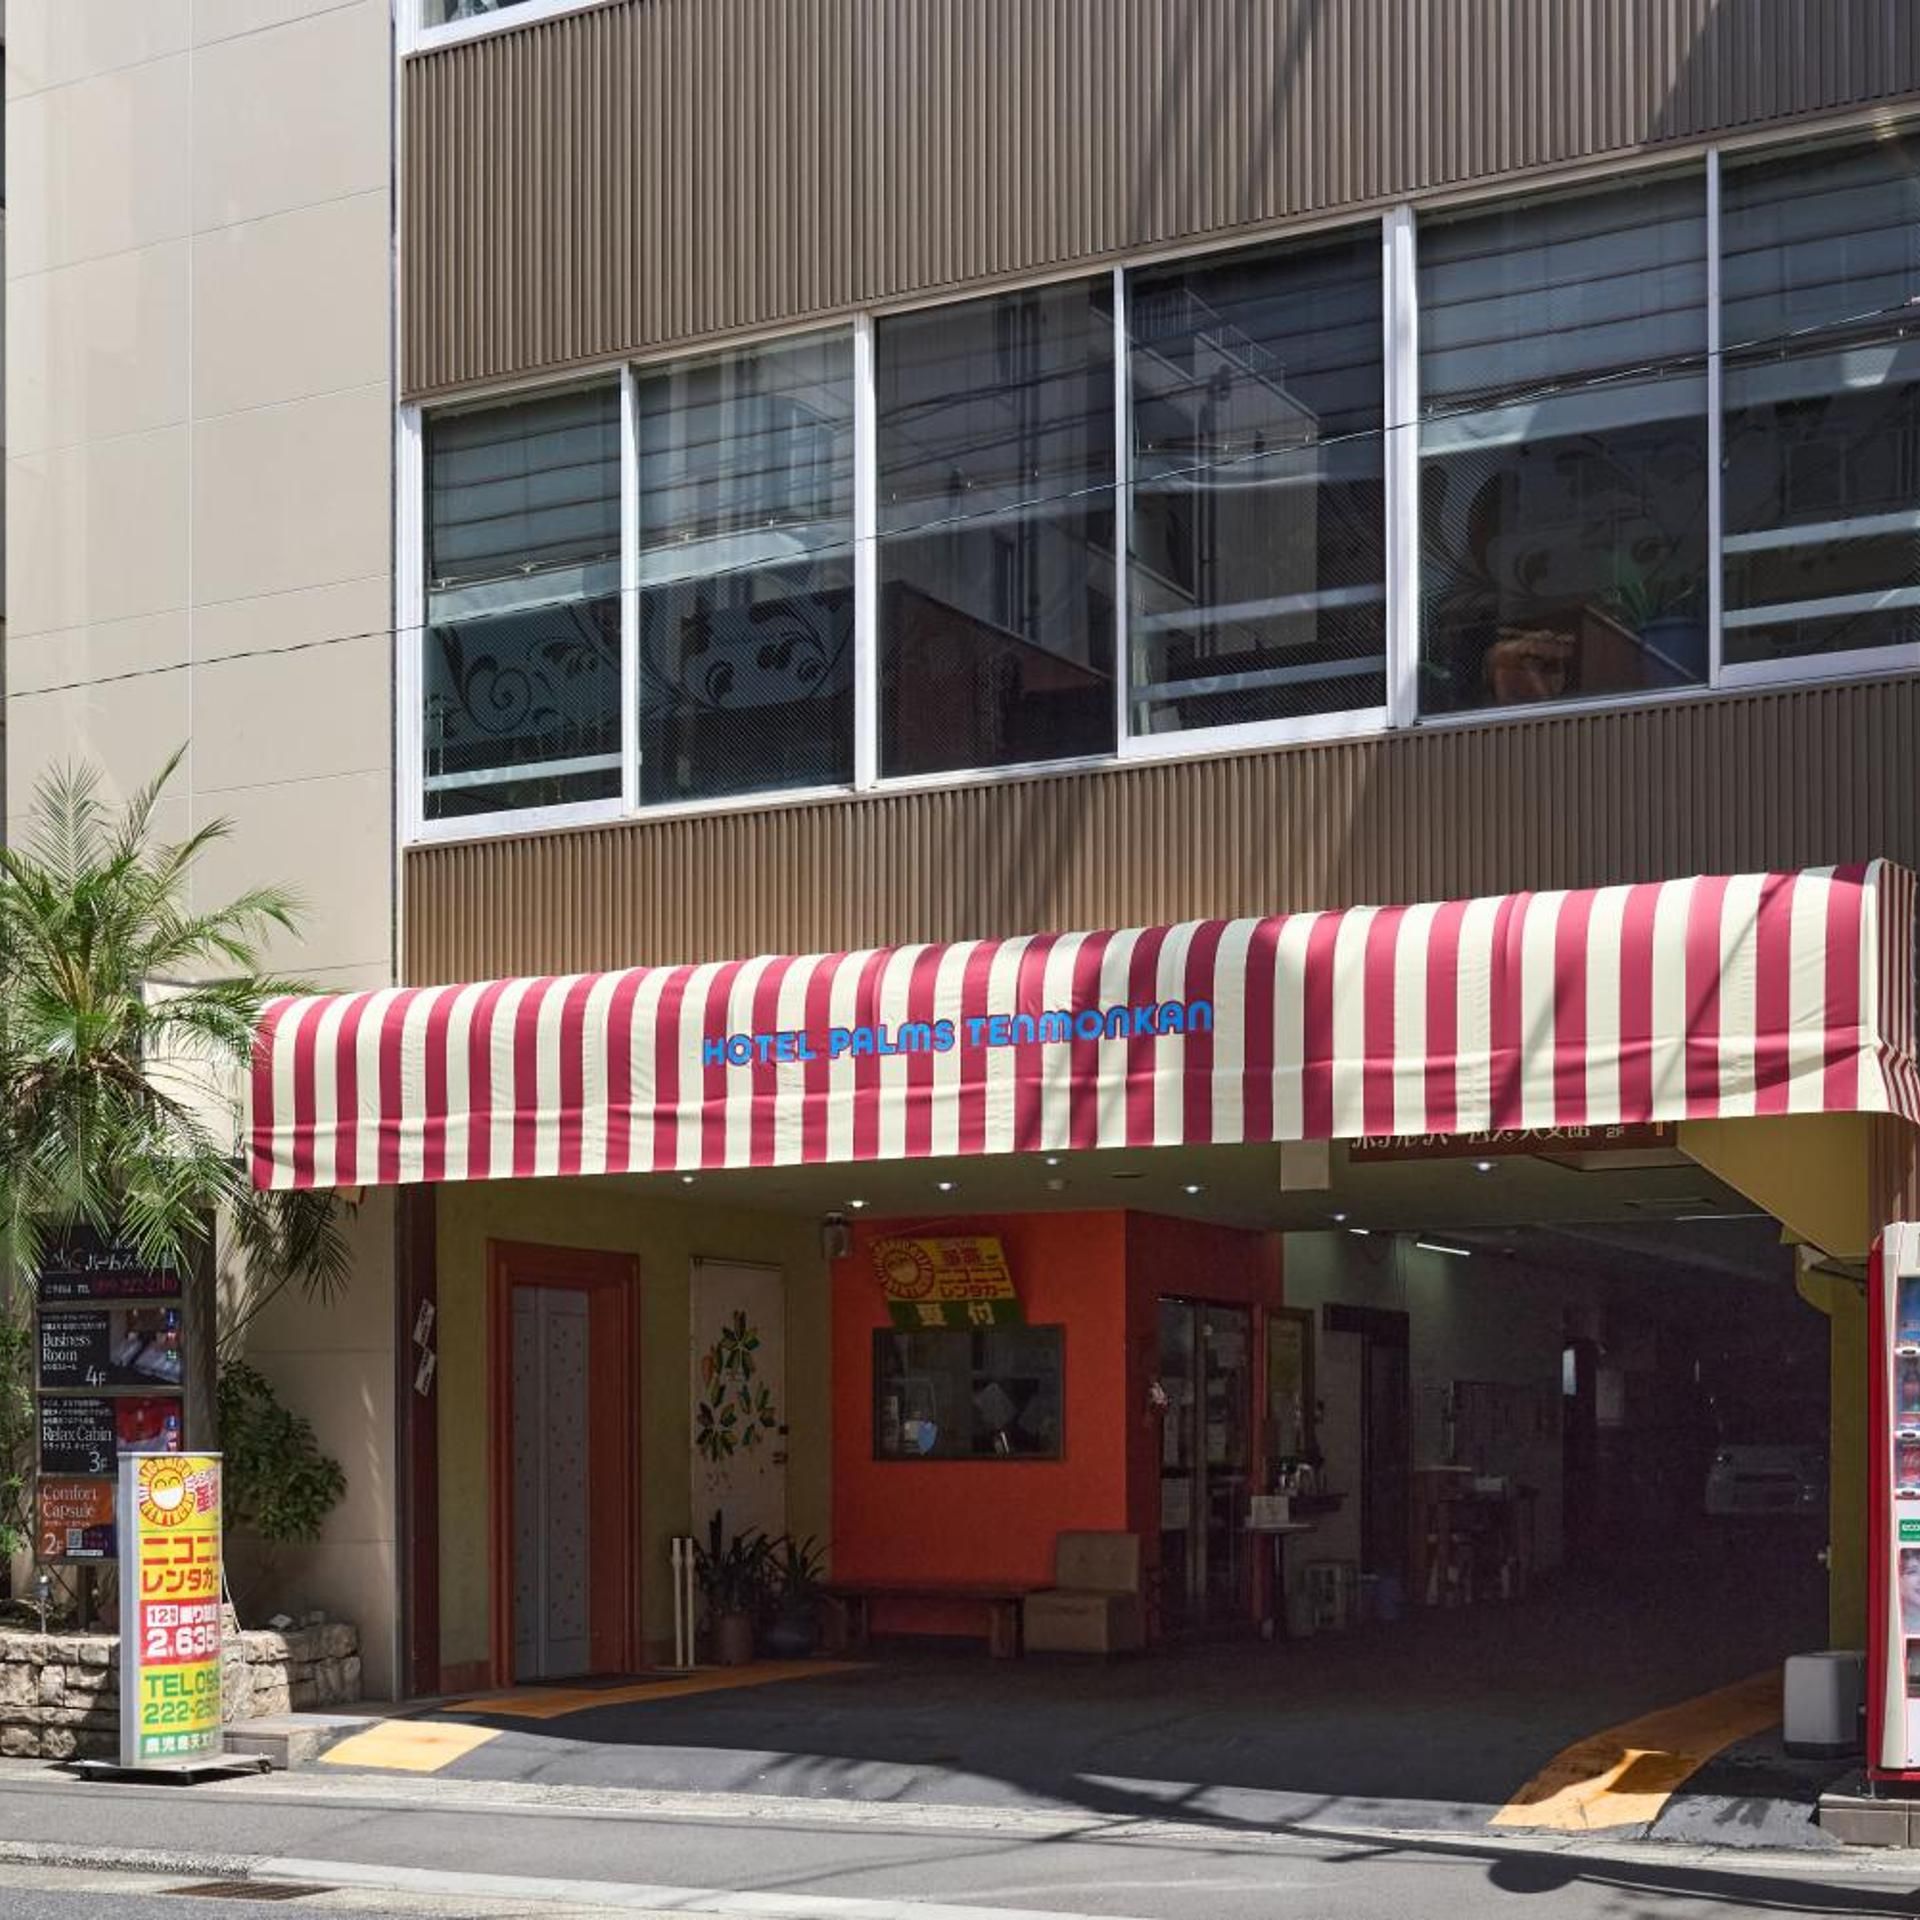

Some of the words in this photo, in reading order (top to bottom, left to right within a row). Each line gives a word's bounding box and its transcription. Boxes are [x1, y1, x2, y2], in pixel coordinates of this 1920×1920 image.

[703, 1032, 816, 1067] HOTEL
[829, 1020, 956, 1058] PALMS
[966, 1000, 1213, 1048] TENMONKAN
[42, 1332, 91, 1347] Business
[42, 1347, 78, 1362] Room
[85, 1365, 106, 1387] 4F
[43, 1426, 75, 1441] Relax
[76, 1426, 112, 1441] Cabin
[43, 1484, 97, 1501] Comfort
[43, 1501, 96, 1519] Capsule
